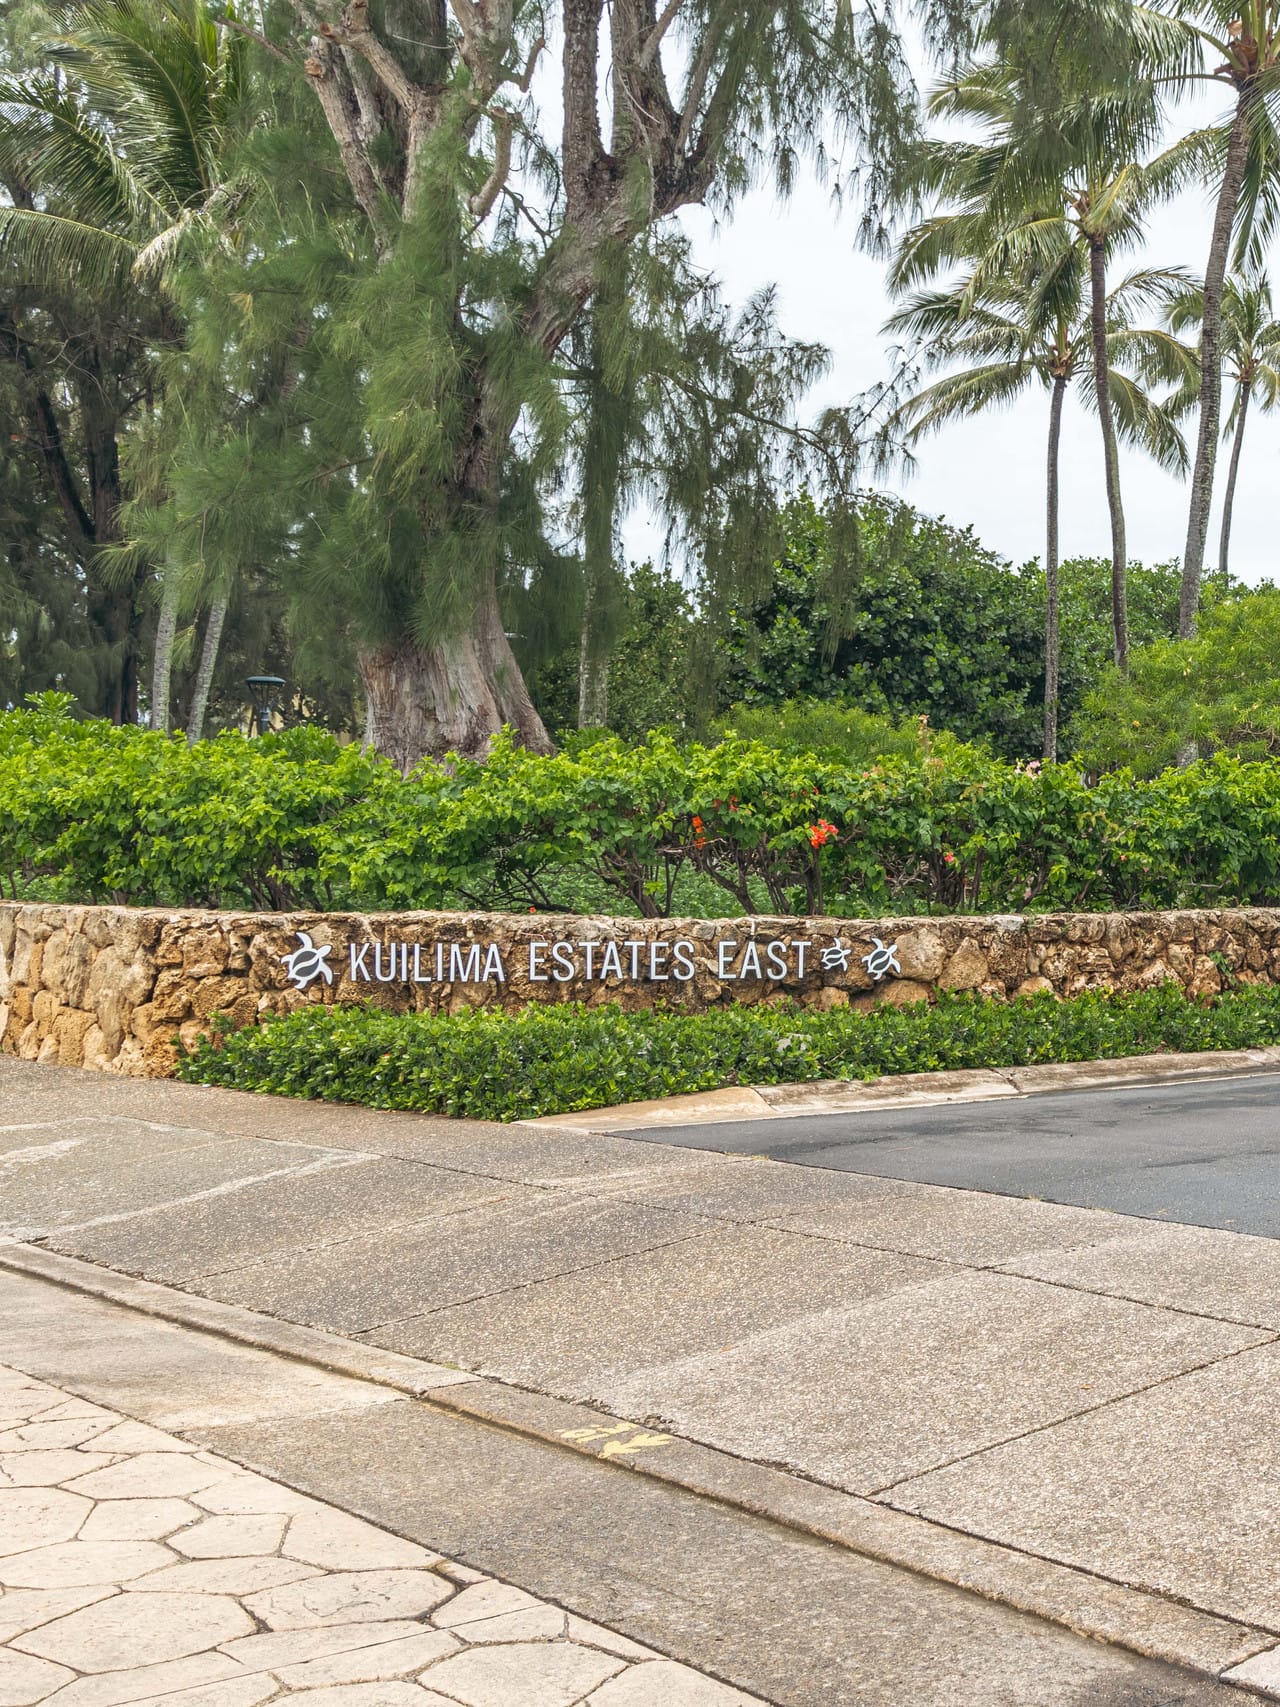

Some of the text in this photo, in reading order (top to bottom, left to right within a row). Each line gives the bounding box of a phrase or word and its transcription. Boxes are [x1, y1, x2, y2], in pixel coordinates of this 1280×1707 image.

[350, 941, 812, 983] KUILIMA ESTATES EAST
